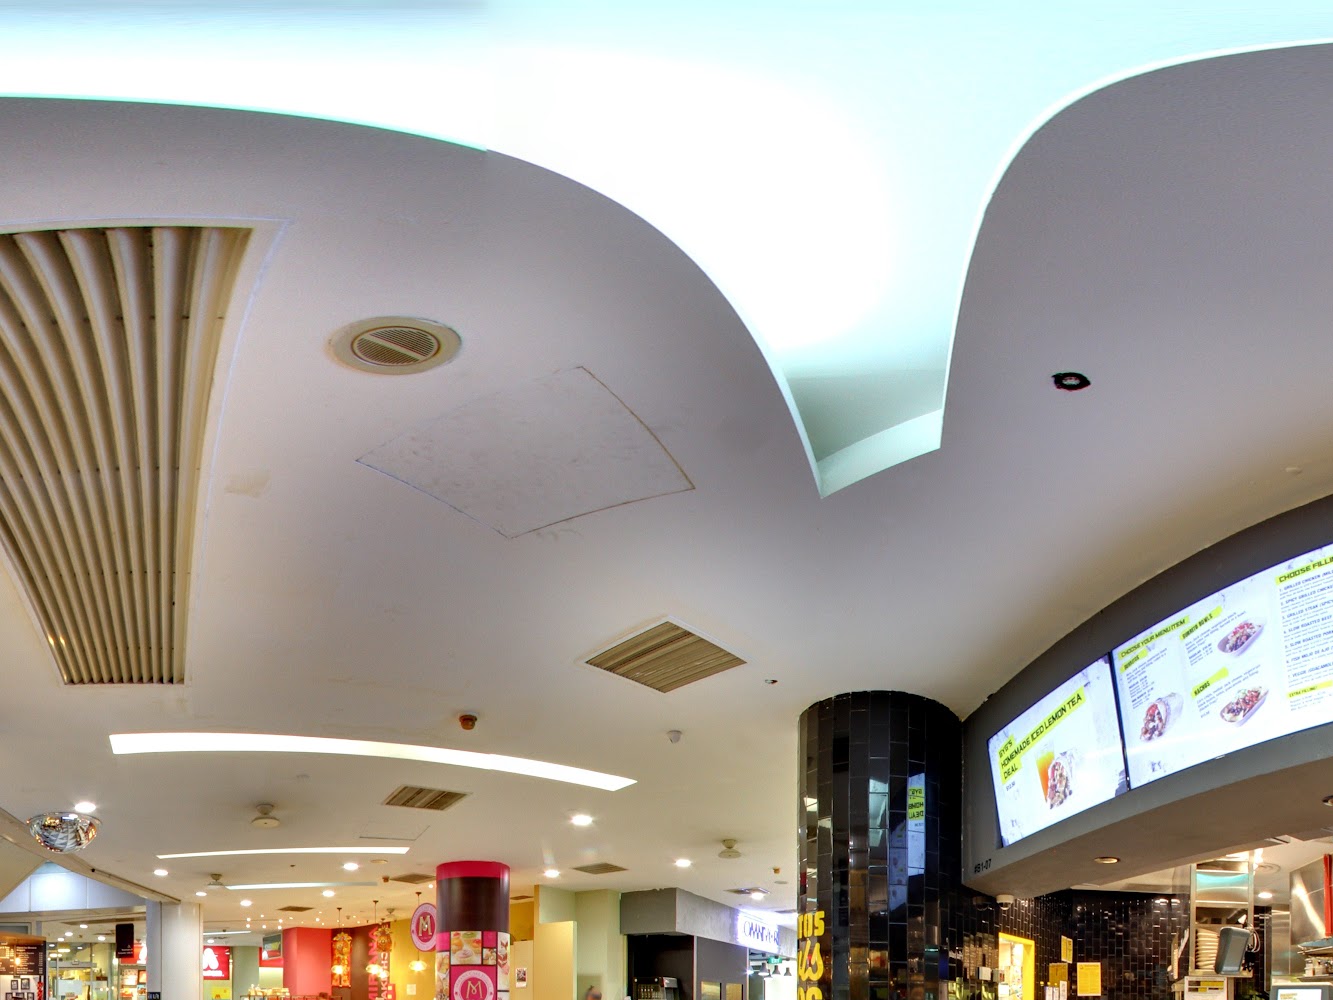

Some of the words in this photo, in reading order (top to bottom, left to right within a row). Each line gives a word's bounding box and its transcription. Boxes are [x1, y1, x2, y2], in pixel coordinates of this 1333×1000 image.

[1279, 565, 1311, 583] CHOOSE
[1120, 643, 1141, 658] CHOOSE
[1141, 636, 1155, 646] YOUR
[1194, 681, 1210, 696] NACHOS
[1001, 737, 1031, 769] HOMEMADE
[1031, 725, 1044, 741] ICED
[1044, 705, 1067, 730] LEMON
[1066, 693, 1082, 710] TEA
[1004, 763, 1018, 780] DEAL
[417, 914, 433, 937] M
[465, 980, 483, 999] M
